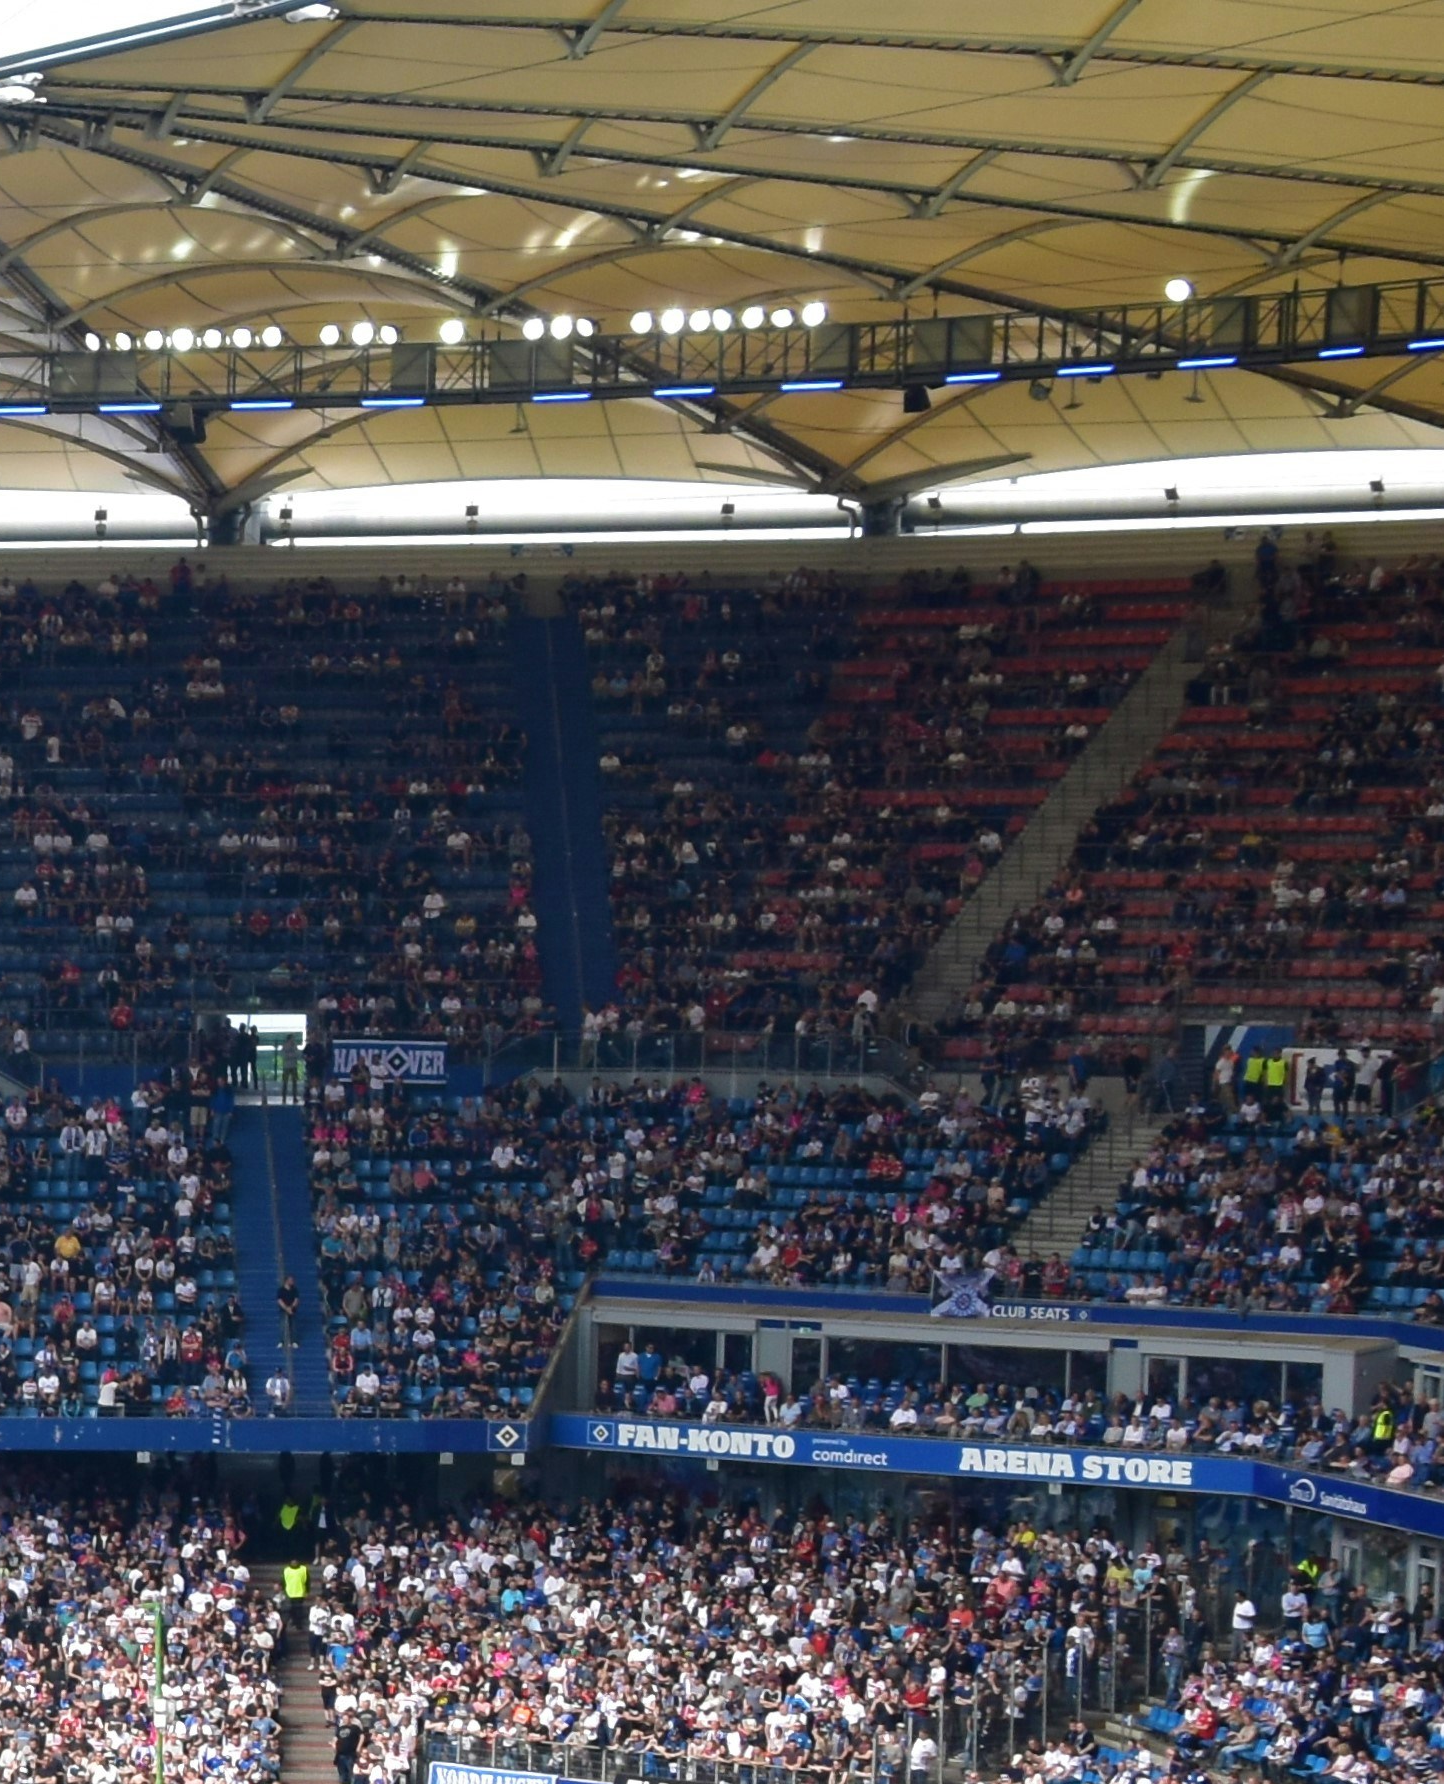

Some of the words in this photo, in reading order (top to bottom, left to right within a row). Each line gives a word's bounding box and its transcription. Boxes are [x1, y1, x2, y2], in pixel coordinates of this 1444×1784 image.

[992, 1304, 1026, 1318] CLUB
[1030, 1306, 1071, 1320] SEATS
[618, 1423, 795, 1457] FAN-KONTO
[811, 1446, 888, 1467] comdirect
[959, 1447, 1075, 1477] ARENA
[1082, 1456, 1193, 1485] STORE
